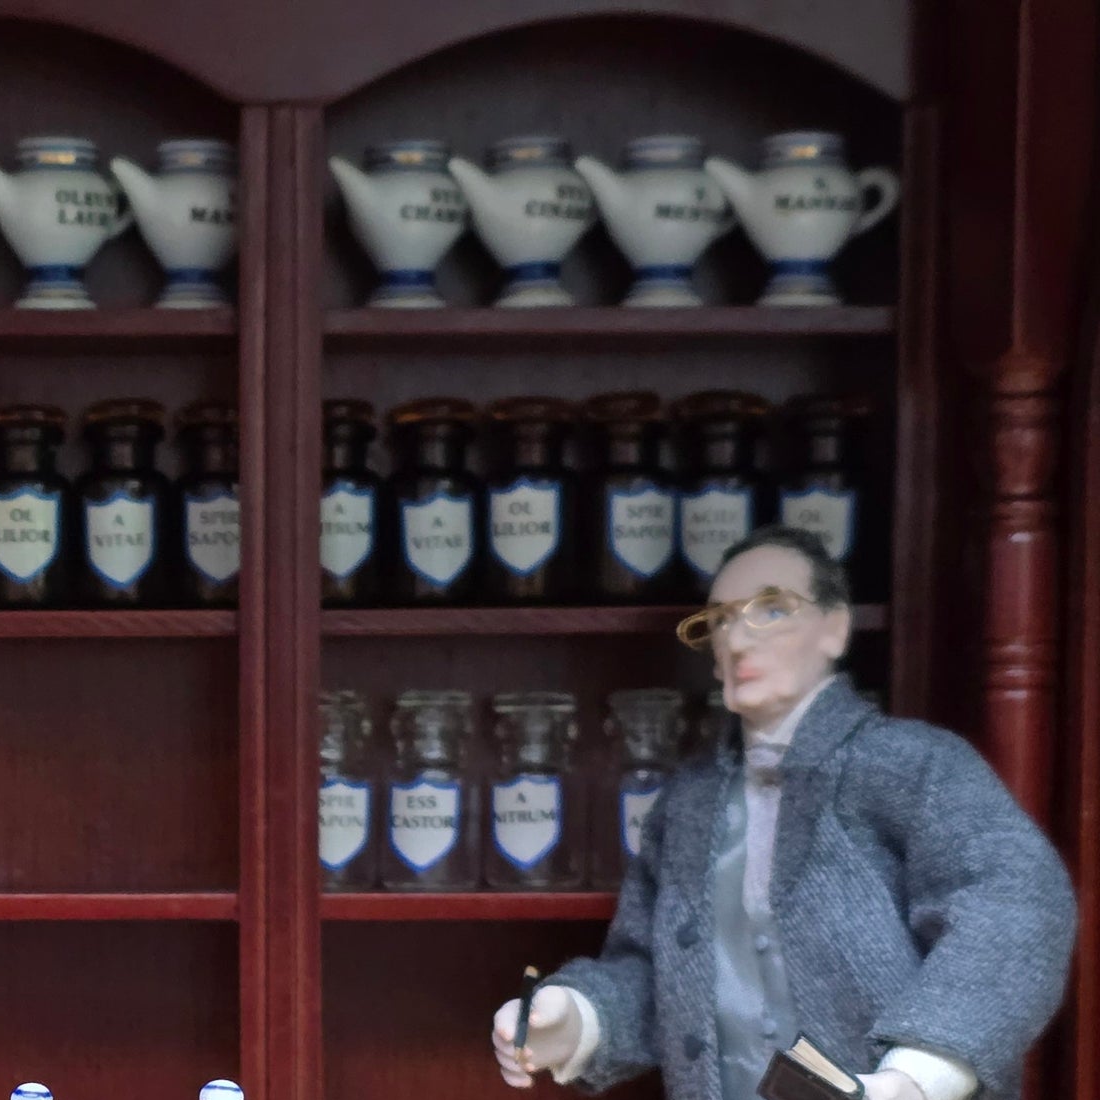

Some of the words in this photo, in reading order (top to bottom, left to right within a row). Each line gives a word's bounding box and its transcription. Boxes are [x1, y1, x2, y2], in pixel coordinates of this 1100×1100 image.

[10, 509, 34, 522] OL
[508, 502, 532, 516] OL
[404, 795, 434, 808] ESS
